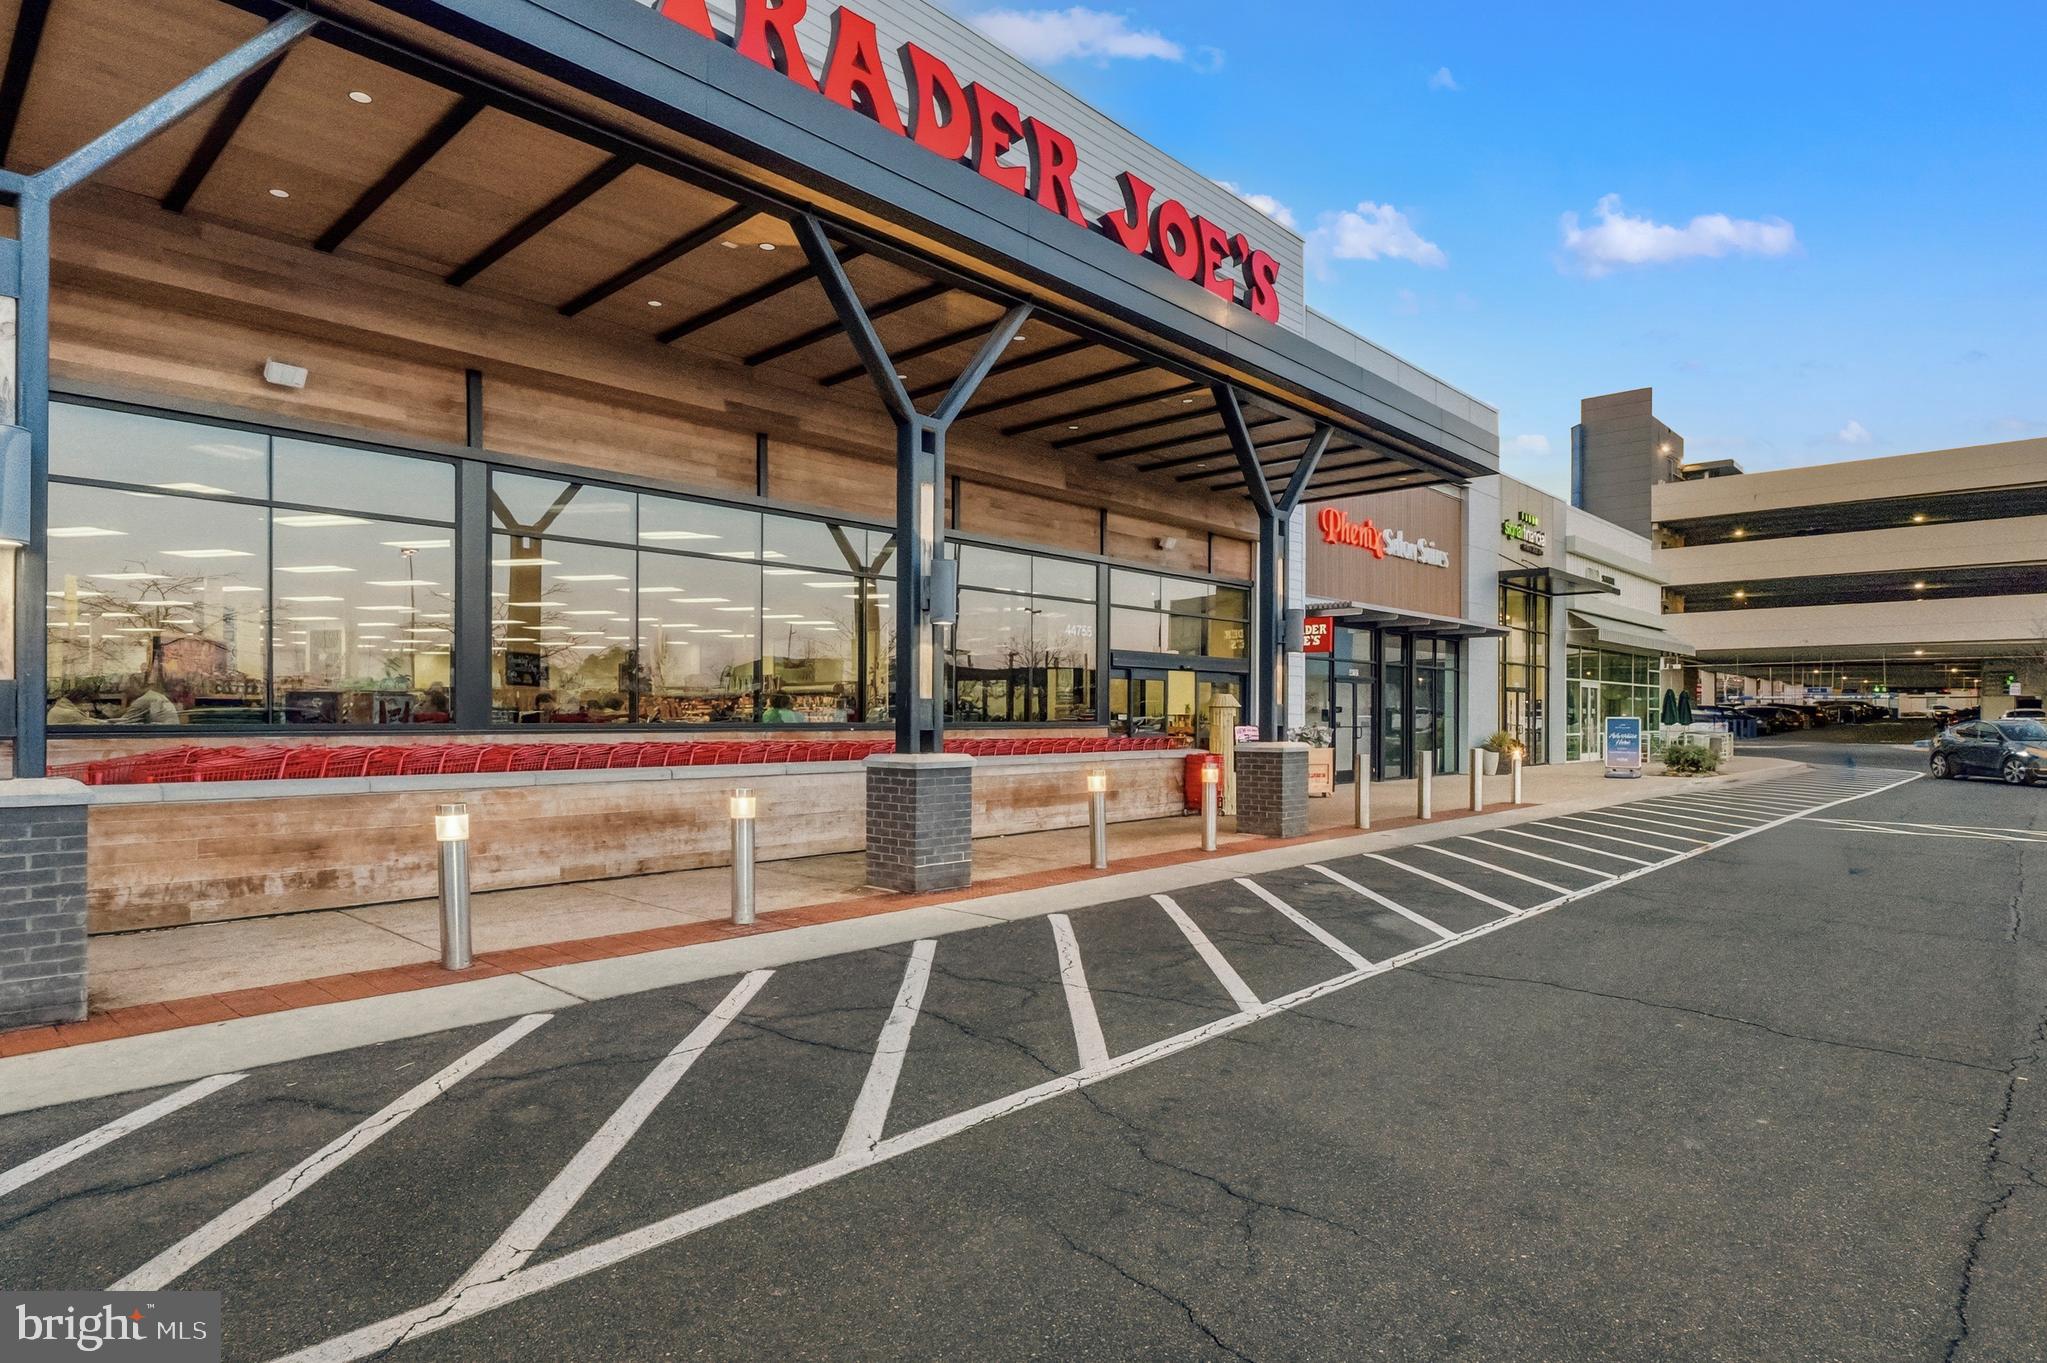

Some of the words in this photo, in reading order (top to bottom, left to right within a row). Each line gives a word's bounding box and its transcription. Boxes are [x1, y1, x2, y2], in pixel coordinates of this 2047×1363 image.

[656, 0, 1088, 229] RADER
[1098, 171, 1280, 325] JOE'S
[1318, 506, 1384, 560] Phenix
[1304, 623, 1327, 635] DER
